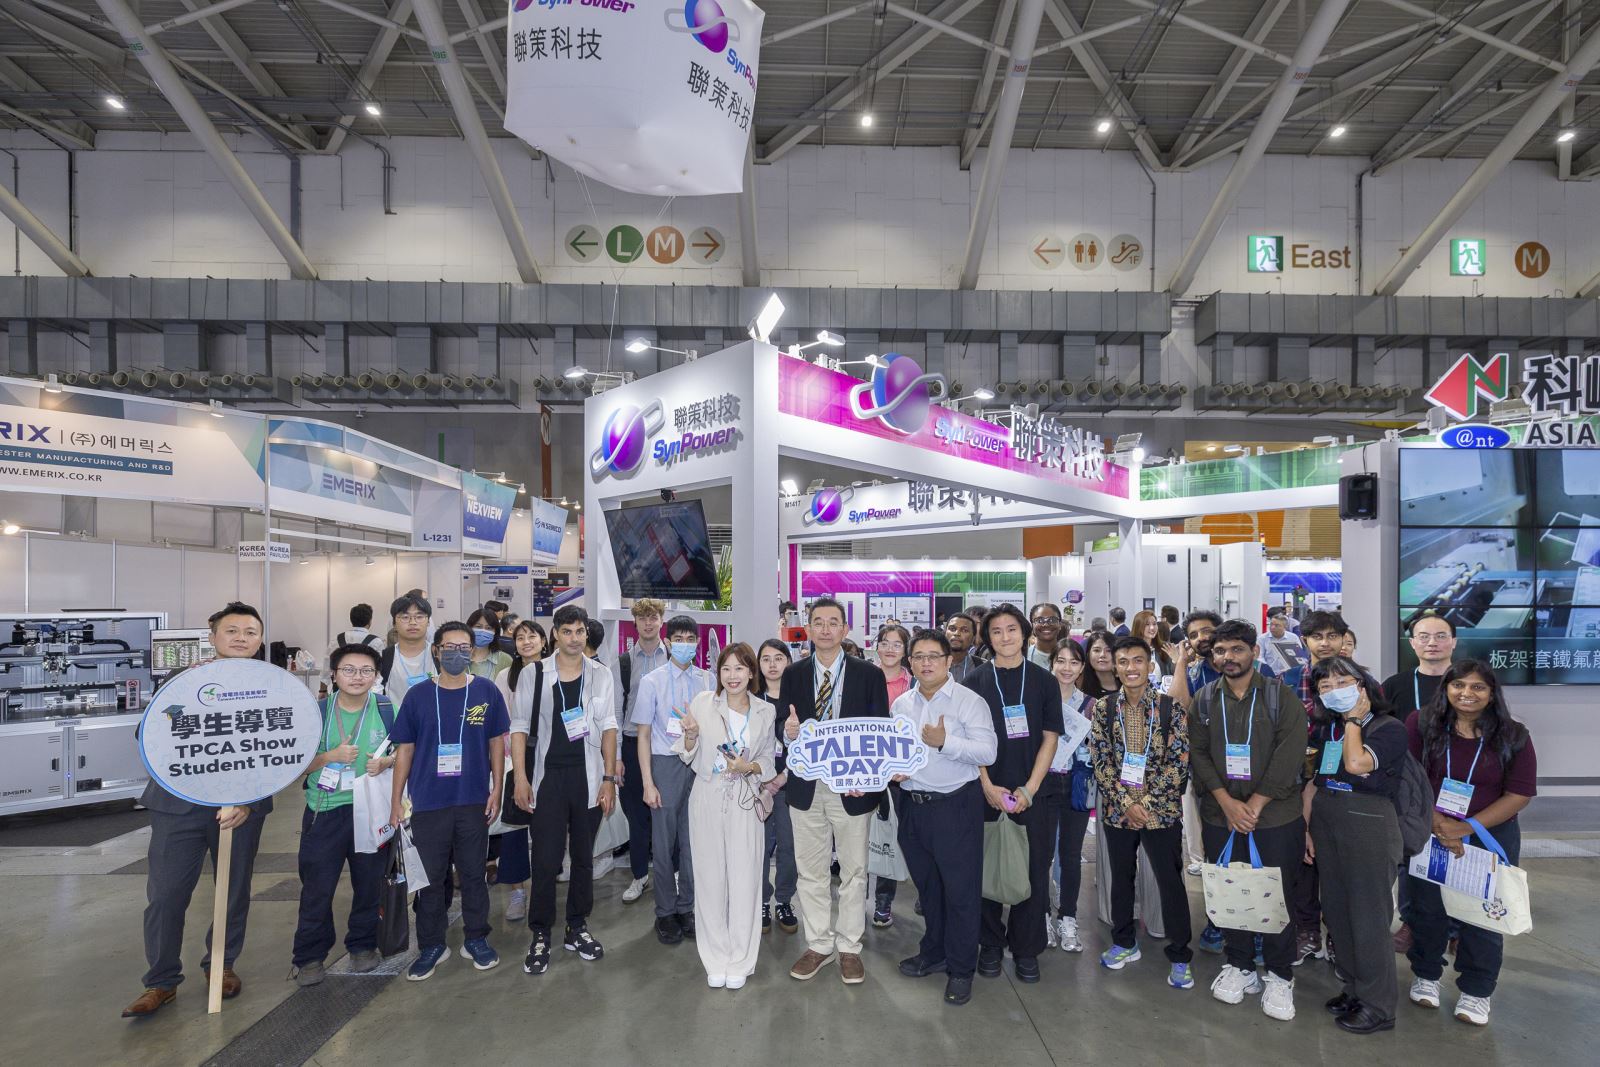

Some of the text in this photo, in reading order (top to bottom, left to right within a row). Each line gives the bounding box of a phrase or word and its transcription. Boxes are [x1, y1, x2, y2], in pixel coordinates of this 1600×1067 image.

[514, 26, 602, 62] 聯策科技
[687, 61, 750, 133] 聯策科技
[616, 231, 676, 258] L M
[1292, 244, 1351, 268] East
[1129, 255, 1140, 265] 1F
[1522, 247, 1543, 273] M
[673, 393, 738, 428] 聯策科技
[653, 427, 736, 462] SynPower
[935, 416, 1007, 453] SynPower
[1011, 404, 1105, 482] 聯策科技
[1528, 423, 1597, 445] ASIA
[36, 452, 124, 467] MANUFACTURING
[128, 461, 148, 469] AND
[152, 463, 171, 471] R&D
[323, 472, 376, 500] EMERIX
[466, 499, 503, 521] NEXVIEW
[848, 508, 902, 524] SynPower
[423, 533, 452, 543] L-1231
[171, 706, 294, 740] 學生導覽
[815, 723, 899, 738] INTERNATIONAL
[175, 737, 297, 759] TPCA Show
[805, 734, 915, 763] TALENT
[168, 753, 305, 777] Student Tour
[831, 758, 884, 777] DAY
[835, 777, 881, 787] 國際人才日
